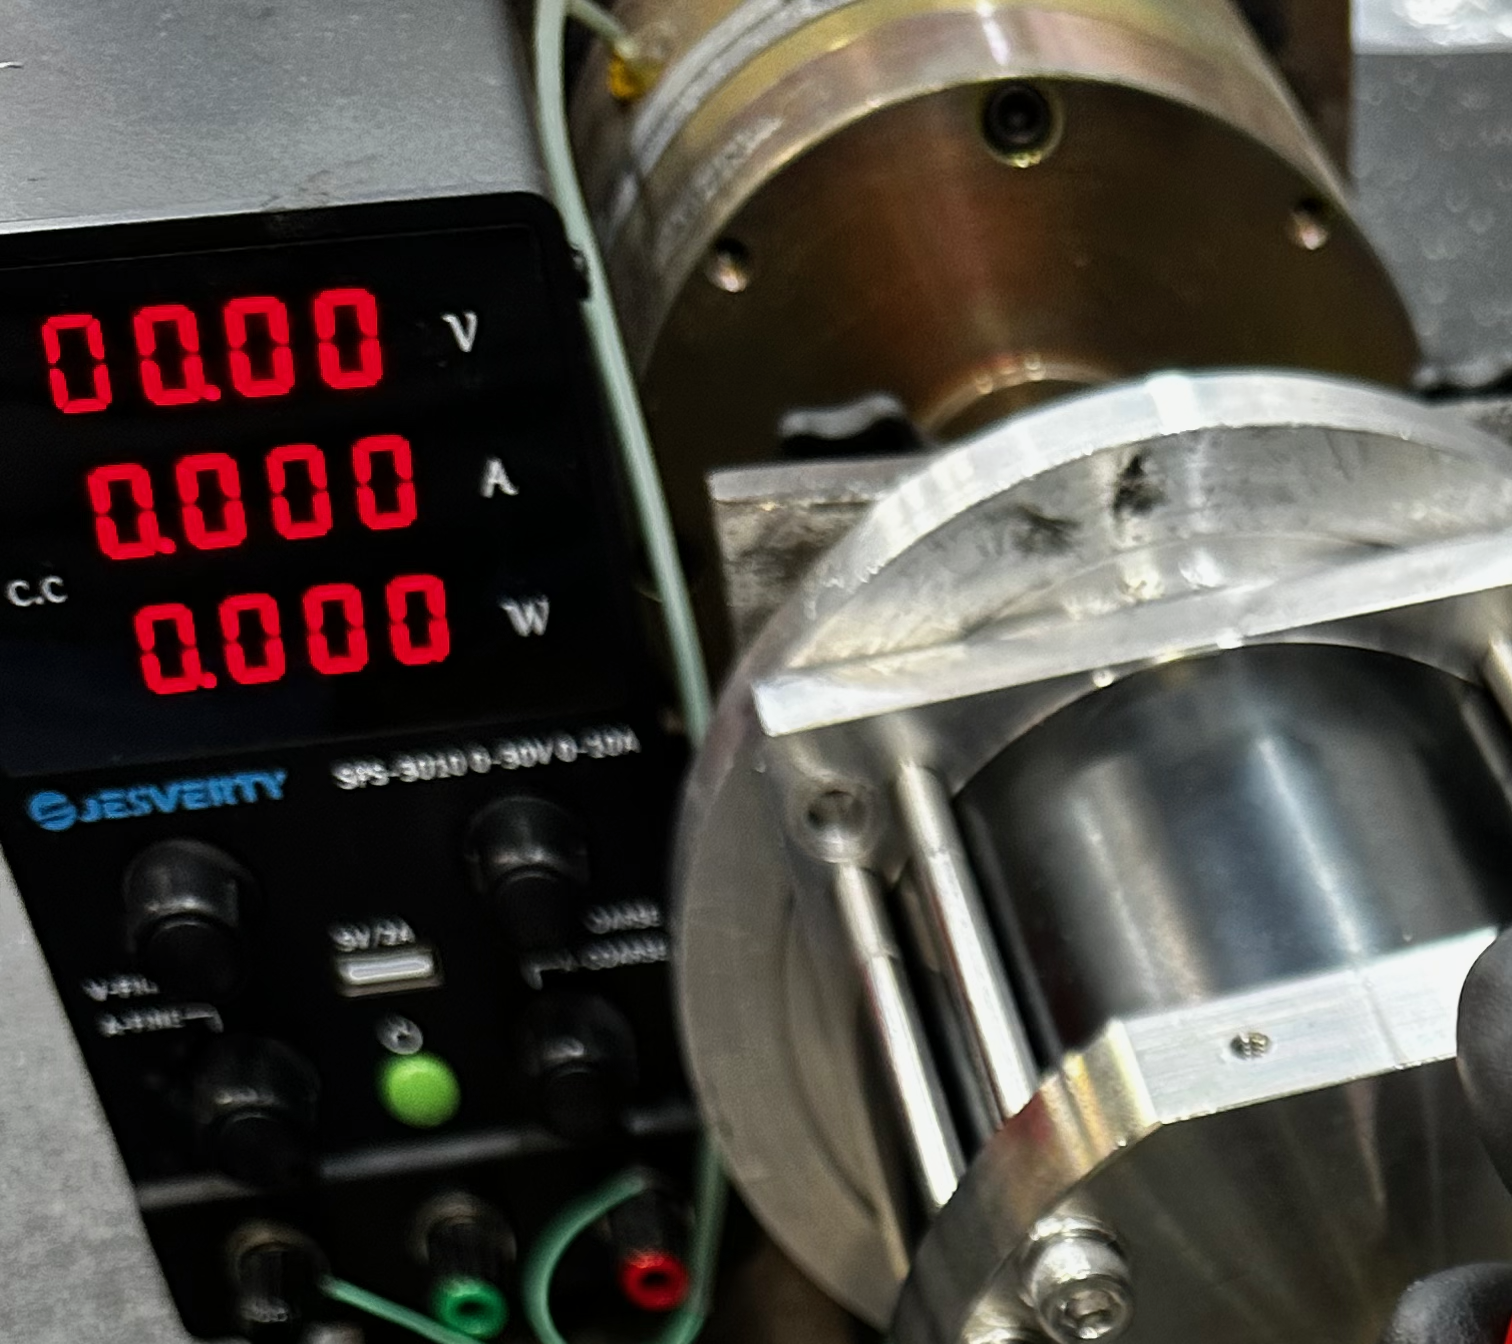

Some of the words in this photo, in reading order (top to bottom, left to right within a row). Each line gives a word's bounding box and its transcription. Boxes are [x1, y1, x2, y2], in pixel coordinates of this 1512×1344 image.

[42, 288, 383, 413] 00.00
[443, 312, 478, 353] V
[87, 434, 418, 561] 0.000
[482, 458, 519, 498] A
[134, 573, 451, 695] 0.000
[502, 598, 550, 637] W
